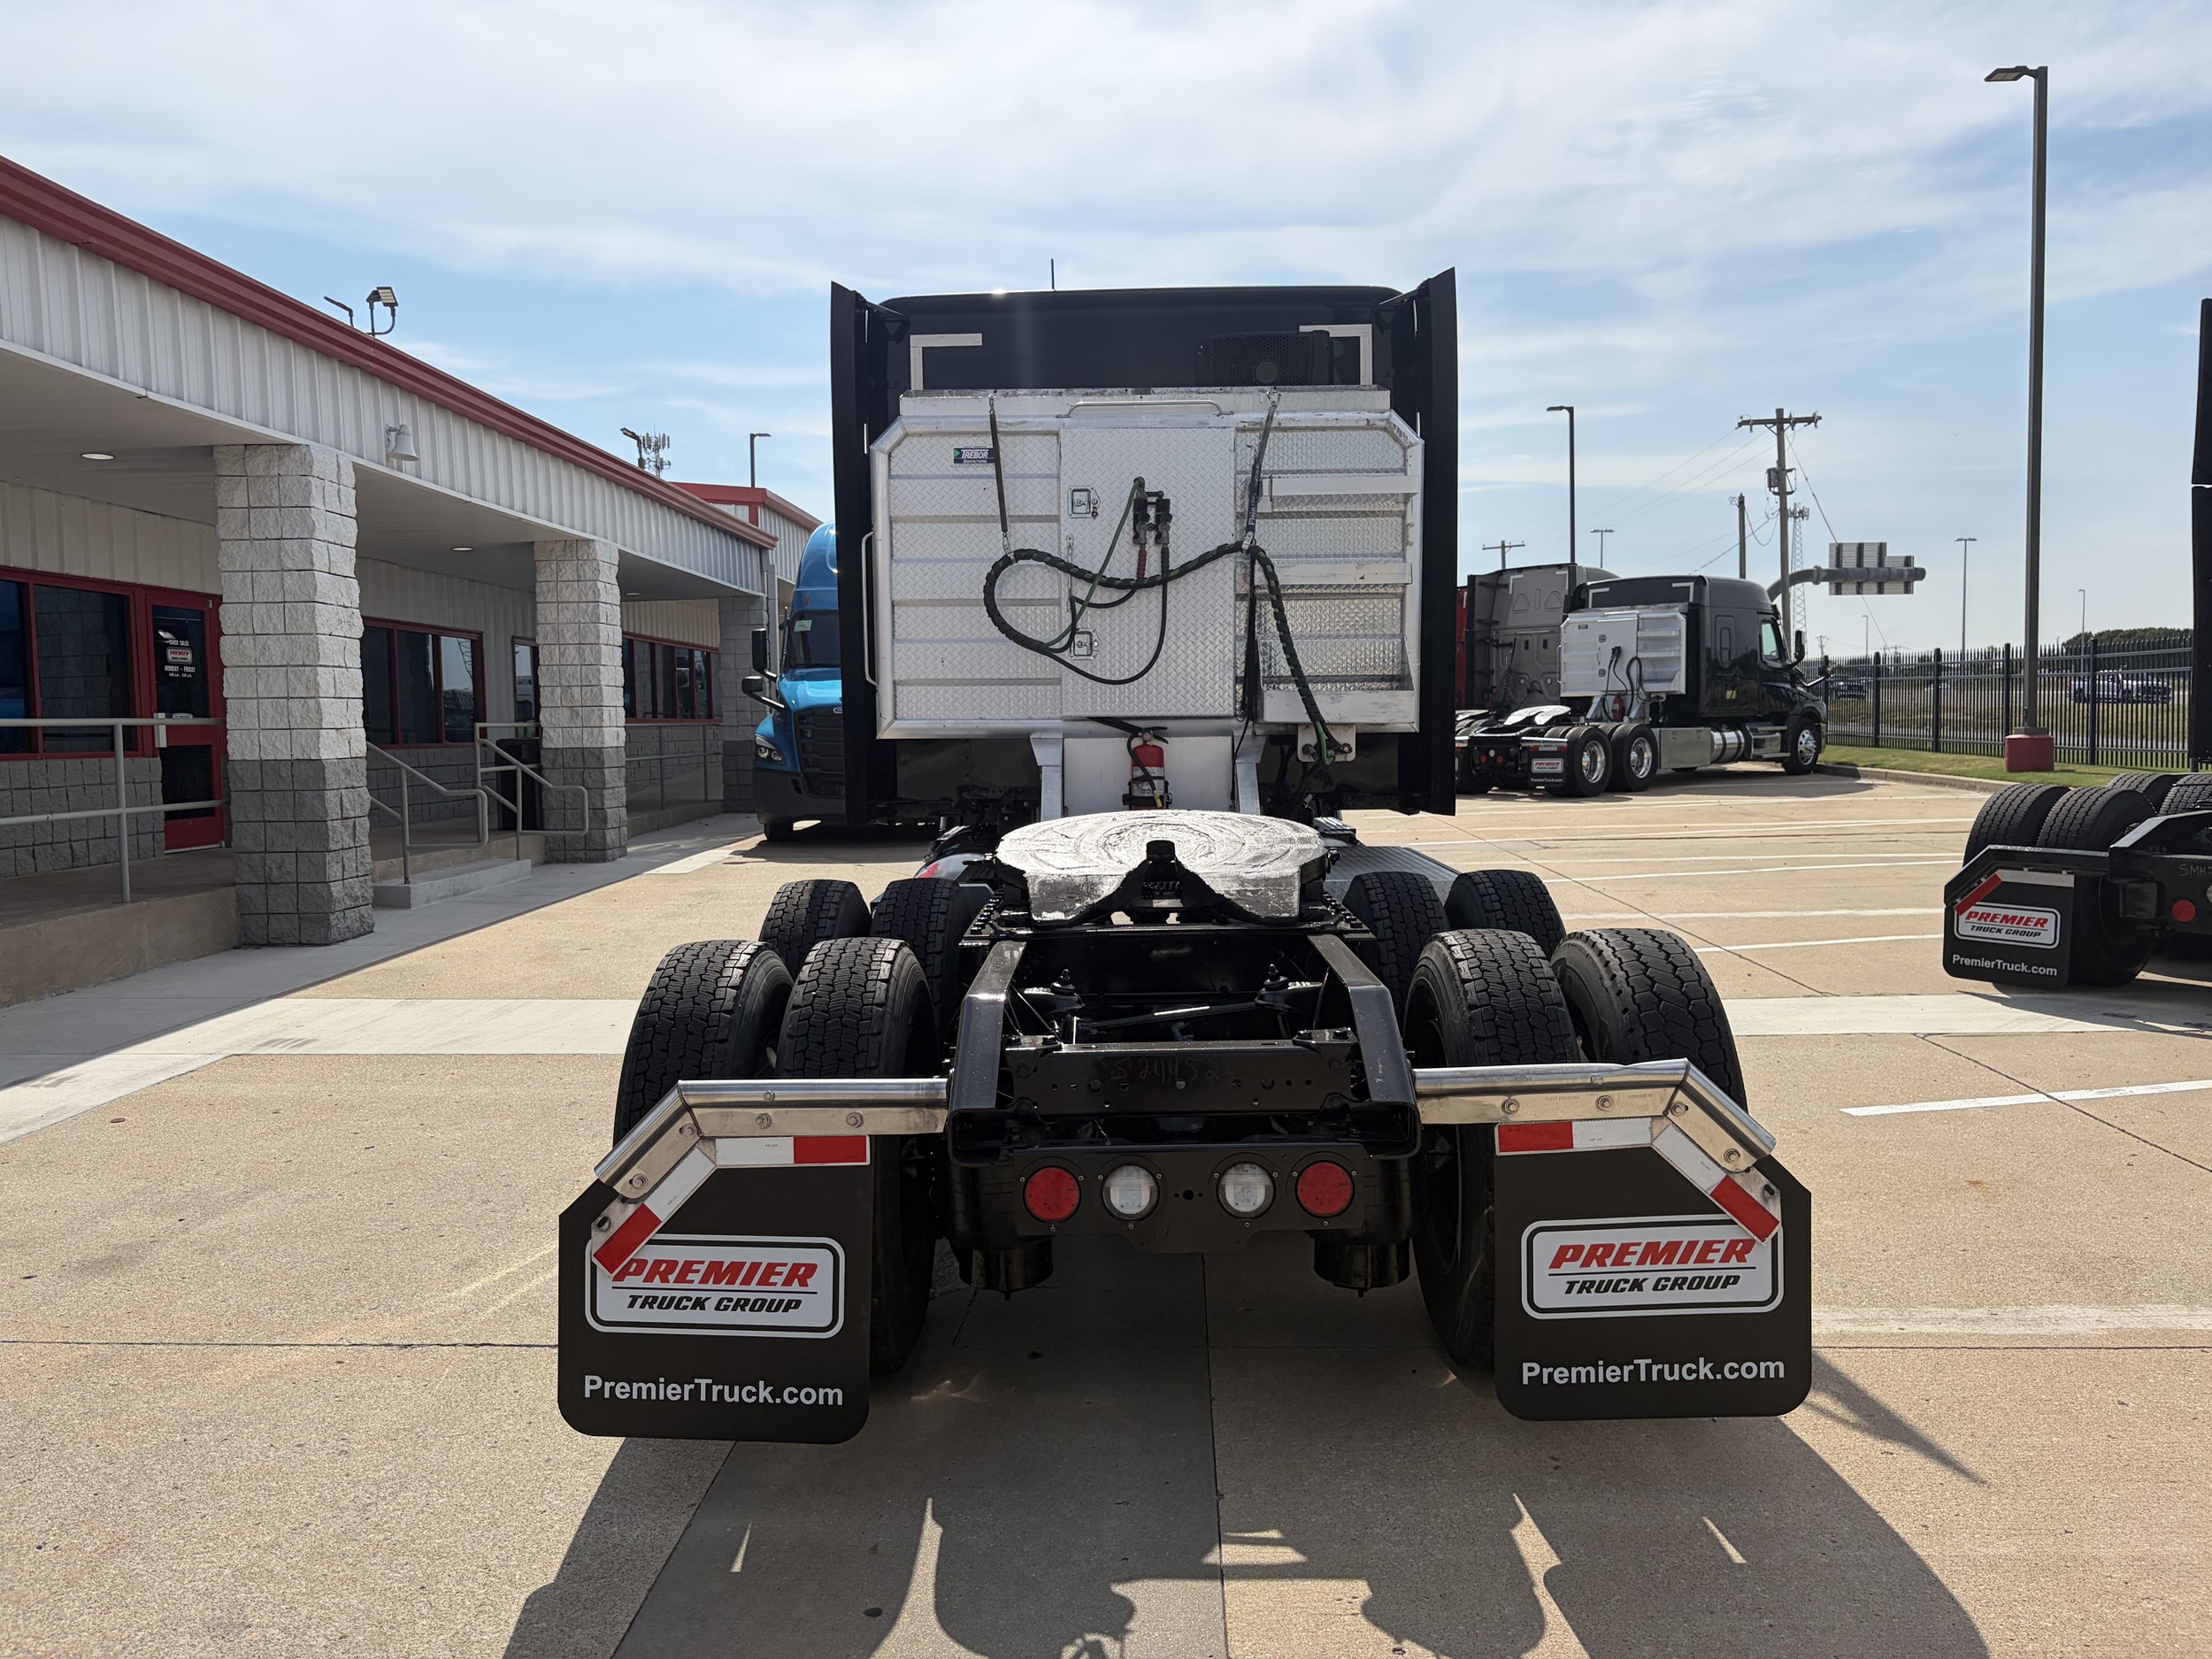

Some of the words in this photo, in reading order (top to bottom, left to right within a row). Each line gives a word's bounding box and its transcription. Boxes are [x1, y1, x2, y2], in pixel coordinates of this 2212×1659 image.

[961, 449, 989, 459] TREBOR
[1965, 910, 2049, 928] PREMIER
[1970, 925, 2004, 934] TRUCK
[2004, 928, 2042, 938] GROUP
[1952, 954, 2058, 977] PremierTruck.com
[1548, 1239, 1756, 1269] PREMIER
[612, 1258, 818, 1287] PREMIER
[1564, 1277, 1649, 1294] TRUCK
[1652, 1275, 1740, 1292] GROUP
[626, 1294, 712, 1311] TRUCK
[714, 1296, 803, 1313] GROUP
[1522, 1356, 1786, 1386] PremierTruck.com
[583, 1374, 844, 1406] PremierTruck.com
